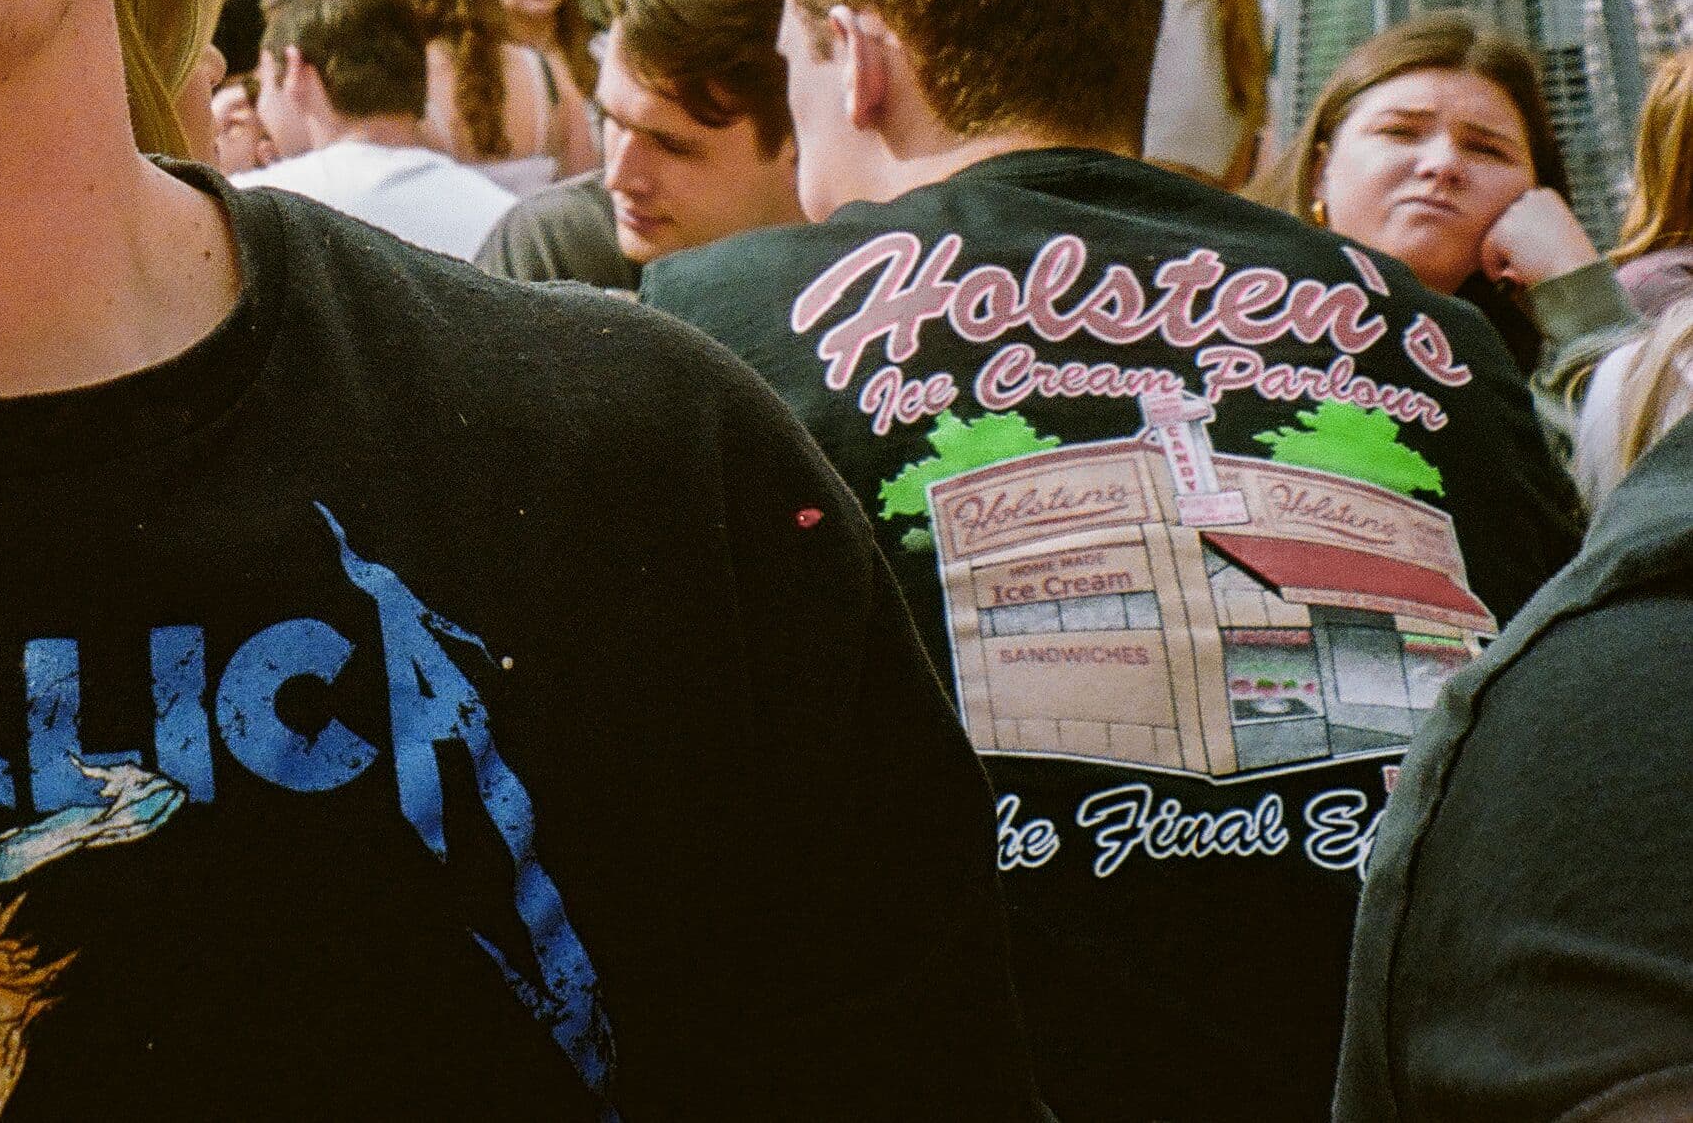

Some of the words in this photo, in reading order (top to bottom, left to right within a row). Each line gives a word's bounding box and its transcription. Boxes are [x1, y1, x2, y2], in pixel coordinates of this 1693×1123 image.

[790, 231, 1473, 391] Holsten's
[859, 365, 959, 437] Ice
[974, 342, 1185, 412] Cream
[1197, 345, 1450, 432] Parlour
[991, 582, 1037, 604] Ice
[1042, 570, 1134, 597] Cream
[999, 645, 1150, 665] SANDWICHES
[996, 793, 1061, 871] he
[1076, 783, 1290, 879] Final
